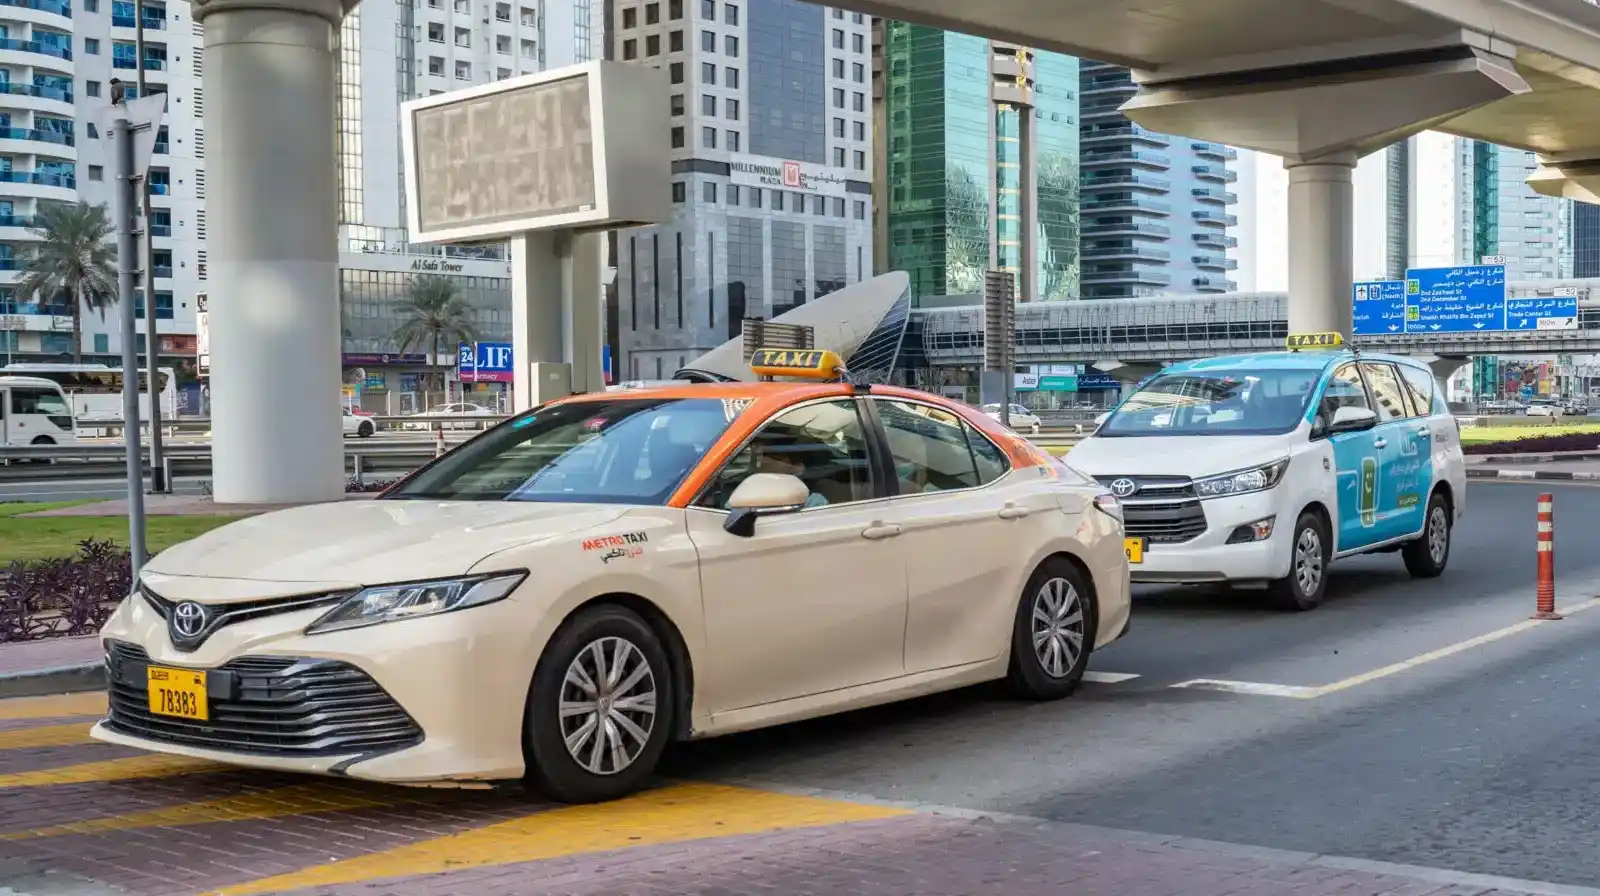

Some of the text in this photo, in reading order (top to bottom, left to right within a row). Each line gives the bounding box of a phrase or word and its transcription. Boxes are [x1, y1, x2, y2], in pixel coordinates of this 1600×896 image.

[731, 161, 781, 177] MILLENNIUM
[760, 176, 781, 185] PLAZA
[411, 259, 464, 272] Al Safa Tower
[1565, 287, 1576, 295] 52
[1294, 334, 1329, 345] TAXI
[461, 351, 474, 362] 24
[763, 351, 815, 367] TAXI
[159, 688, 197, 716] 78383
